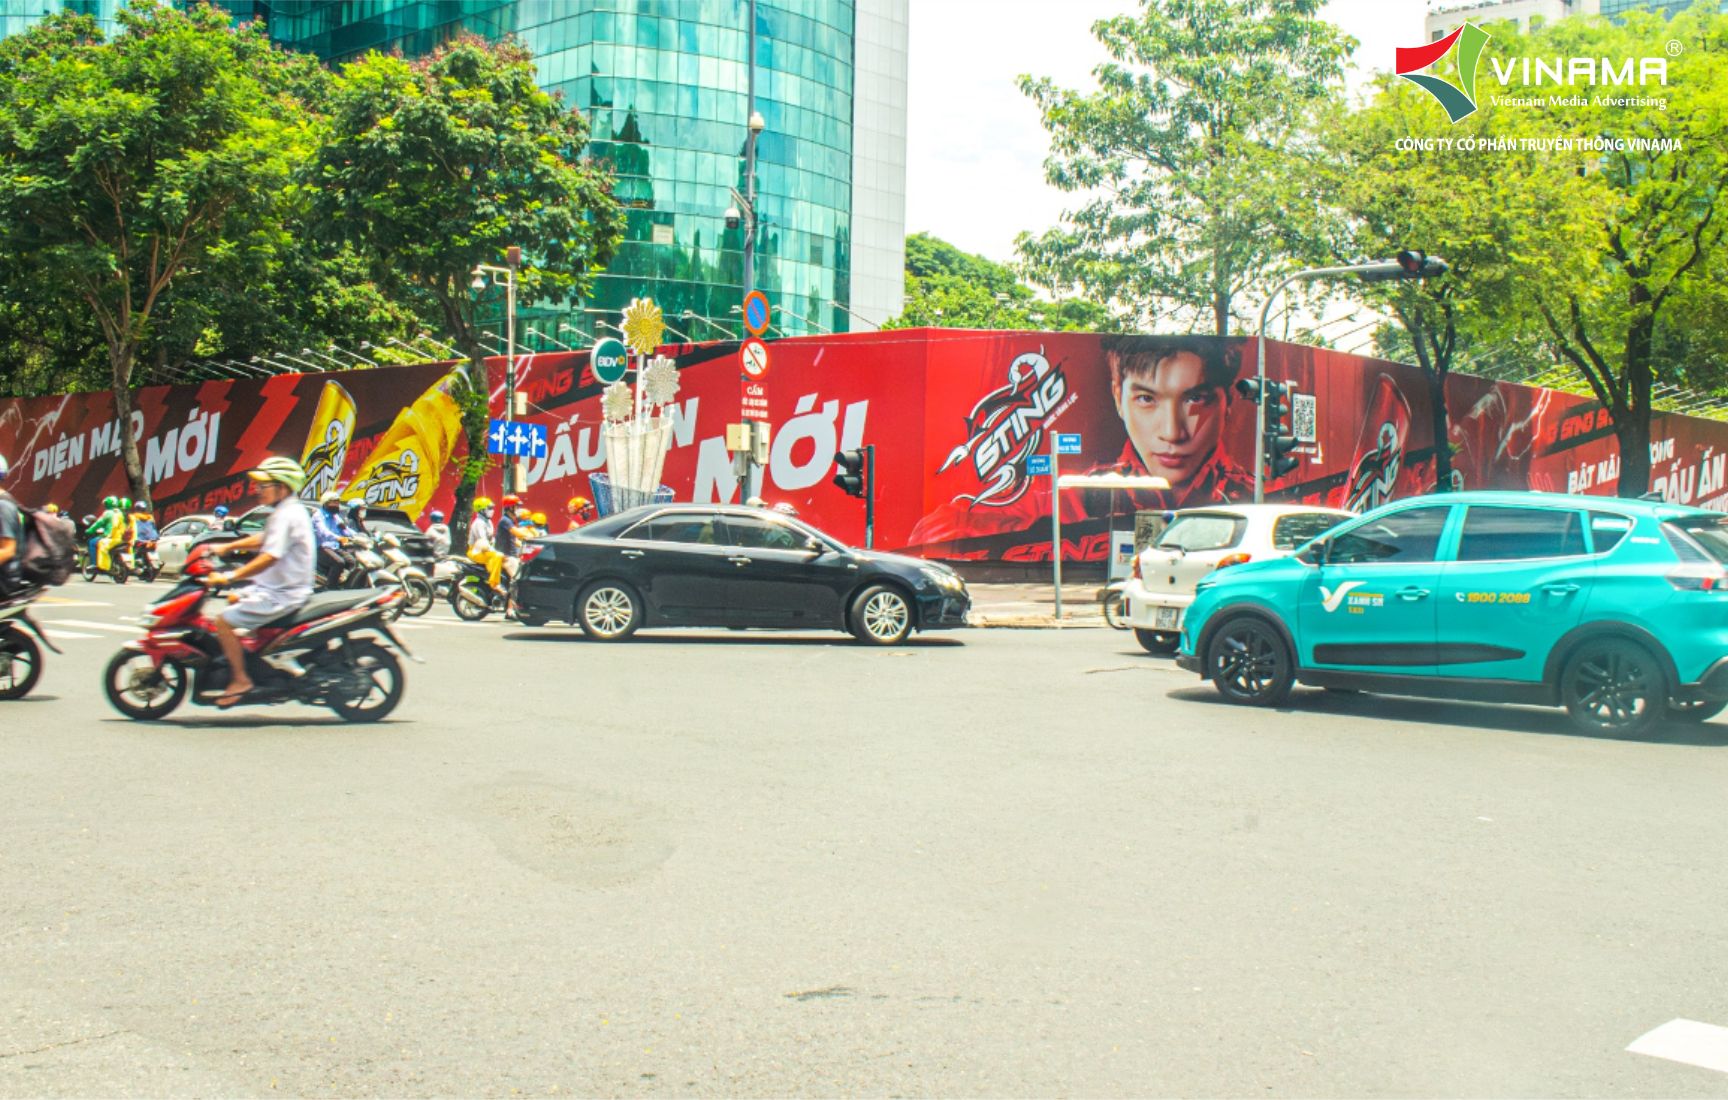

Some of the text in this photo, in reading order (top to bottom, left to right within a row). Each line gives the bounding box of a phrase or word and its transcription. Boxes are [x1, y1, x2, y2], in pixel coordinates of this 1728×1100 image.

[32, 432, 85, 482] DIỆN
[143, 406, 221, 486] MỚI
[693, 392, 869, 505] MỚI
[976, 370, 1067, 478] STING
[365, 475, 419, 505] STING
[1696, 445, 1727, 499] ẤN
